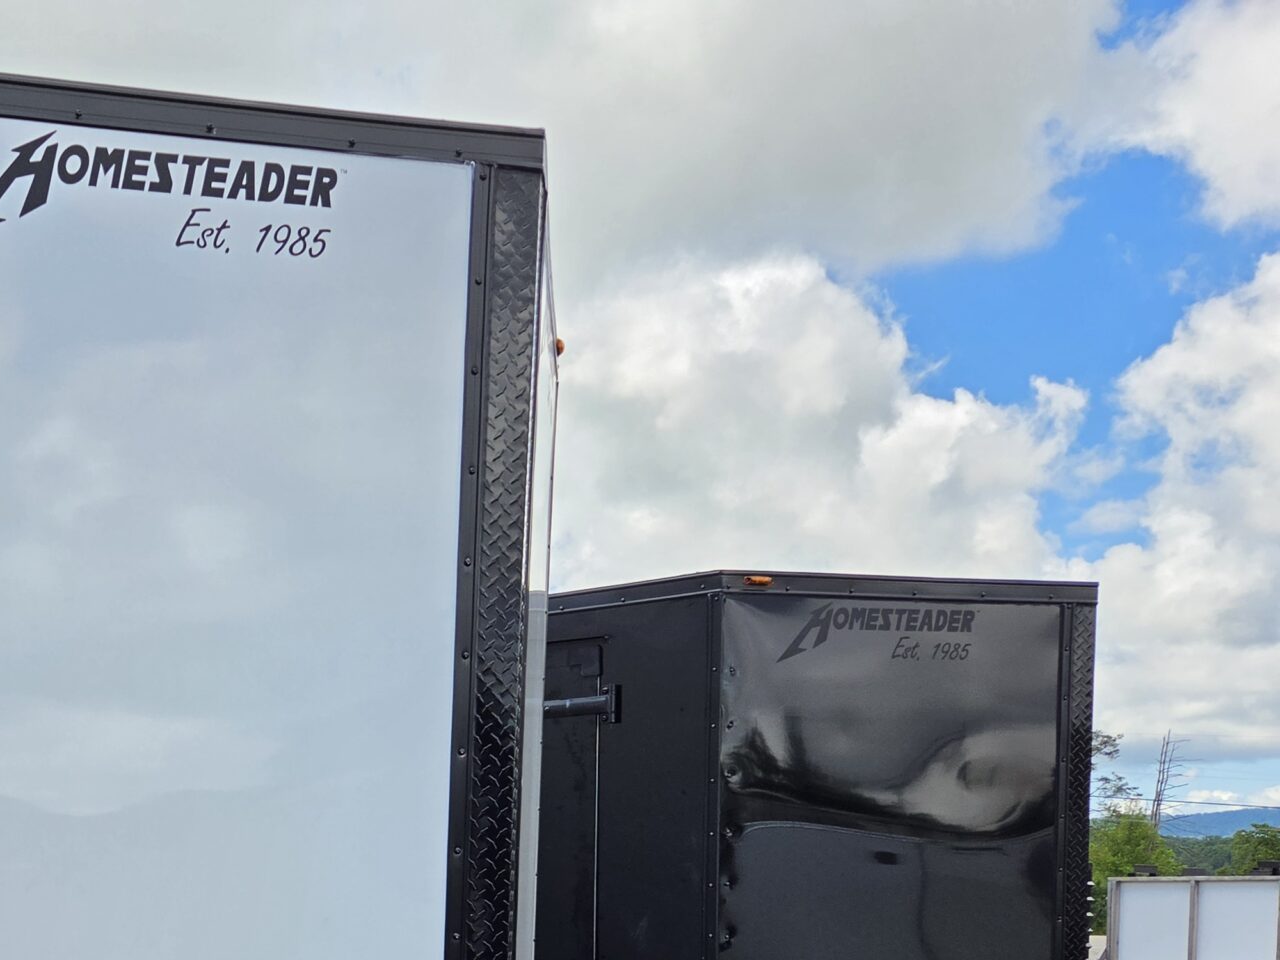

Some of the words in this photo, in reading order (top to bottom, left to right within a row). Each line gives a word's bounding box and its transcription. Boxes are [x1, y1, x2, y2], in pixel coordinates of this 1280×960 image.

[175, 207, 231, 255] Est.
[255, 223, 332, 259] 1985
[776, 601, 976, 664] HOMESTEADER
[891, 636, 921, 662] Est.
[931, 641, 972, 661] 1985
